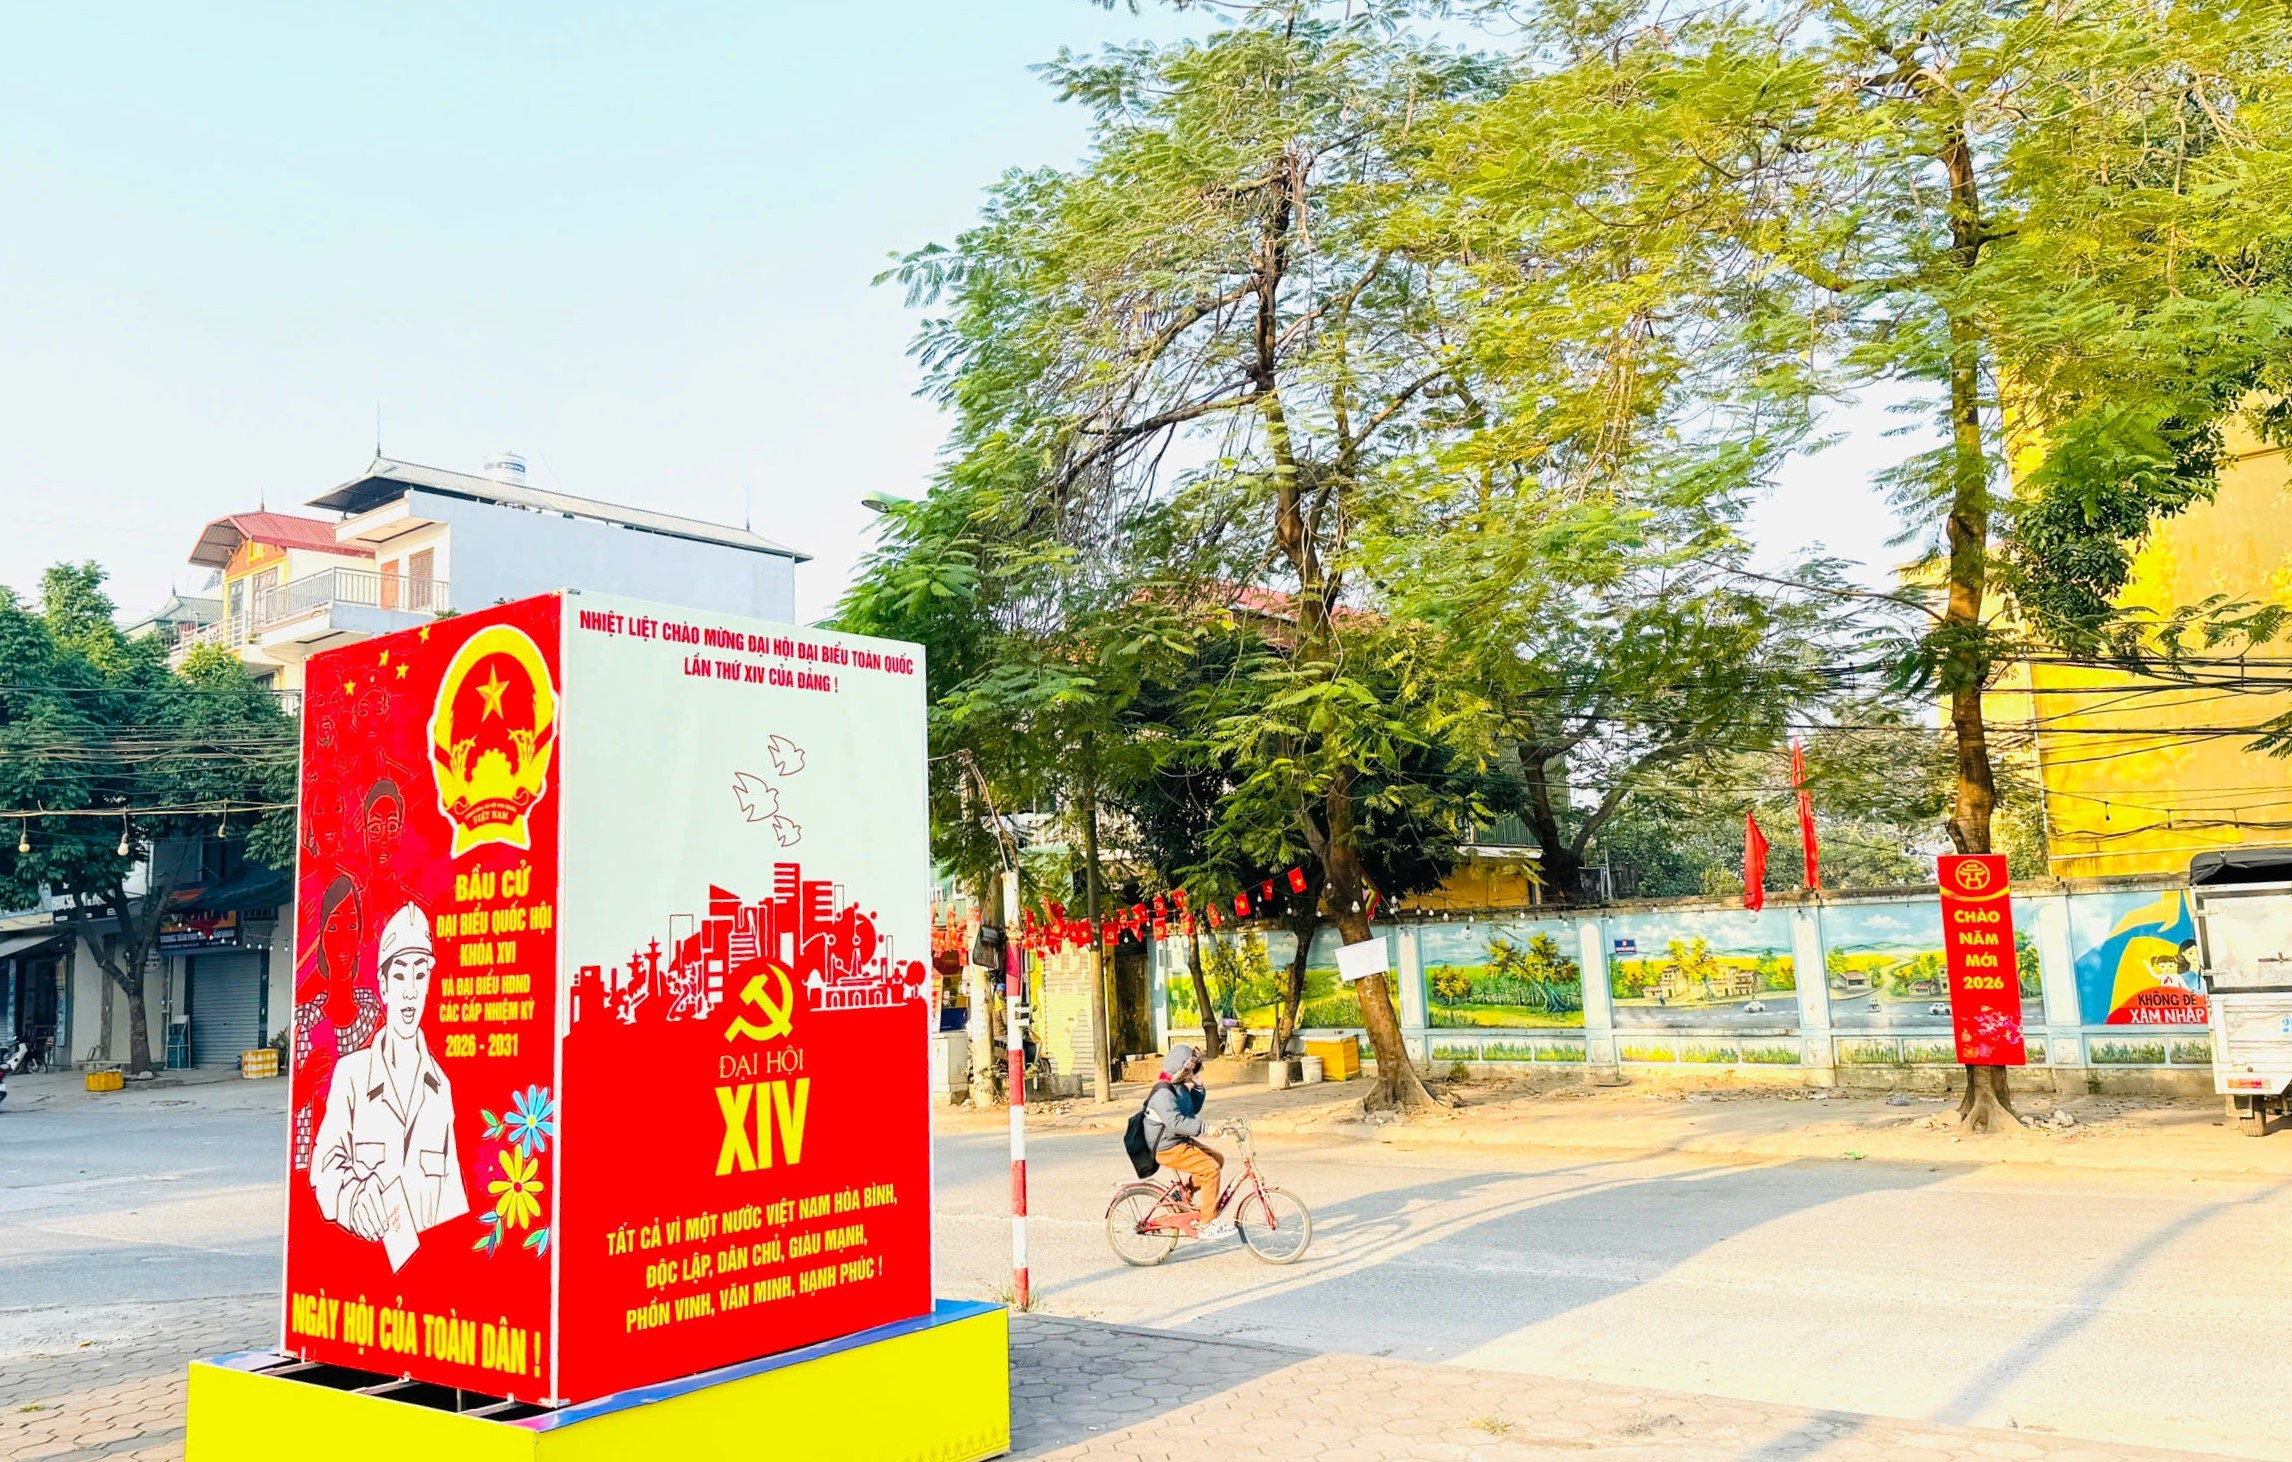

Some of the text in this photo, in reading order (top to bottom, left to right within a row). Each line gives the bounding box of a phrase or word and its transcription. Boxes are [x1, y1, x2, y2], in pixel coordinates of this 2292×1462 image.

[580, 610, 913, 676] NHIỆT LIỆT CHÀO MỪNG ĐẠI HỘI ĐẠI BIỂU TOÀN QUỐC
[684, 652, 711, 678] LẦN
[715, 660, 741, 681] THỨ
[744, 664, 765, 684] XIV
[768, 663, 794, 688] CỦA
[797, 667, 831, 692] ĐẢNG
[455, 859, 532, 902] BẦU CỬ
[436, 899, 552, 942] ĐẠI BIỂU QUỐC HỘI
[1953, 907, 2001, 924] CHÀO
[460, 938, 517, 967] KHÓA XVI
[1958, 930, 2000, 946] NĂM
[1965, 951, 1999, 968] MỚI
[442, 973, 455, 997] VÀ
[456, 977, 474, 1001] ĐẠI
[476, 967, 499, 996] BIỂU
[1962, 976, 2005, 990] 2026
[2137, 991, 2180, 1007] KHÔNG
[440, 995, 535, 1025] CÁC CẤP NHIỆM KỲ
[2129, 1005, 2206, 1025] XÂM NHẬP
[445, 1034, 476, 1058] 2026
[488, 1033, 518, 1057] 2031
[719, 1044, 804, 1080] ĐẠI HỘI
[714, 1077, 811, 1176] XIV
[606, 1181, 898, 1256] TẤT CẢ VÌ MỘT NƯỚC VIỆT NAM HÒA BÌNH,
[646, 1223, 868, 1292] ĐỘC LẬP, DÂN CHỦ, GIÀU MẠNH,
[626, 1254, 883, 1334] PHỒN VINH, VĂN MINH, HẠNH PHÚC !
[292, 1288, 541, 1378] NGÀY HỘI CỦA TOÀN DÂN !
